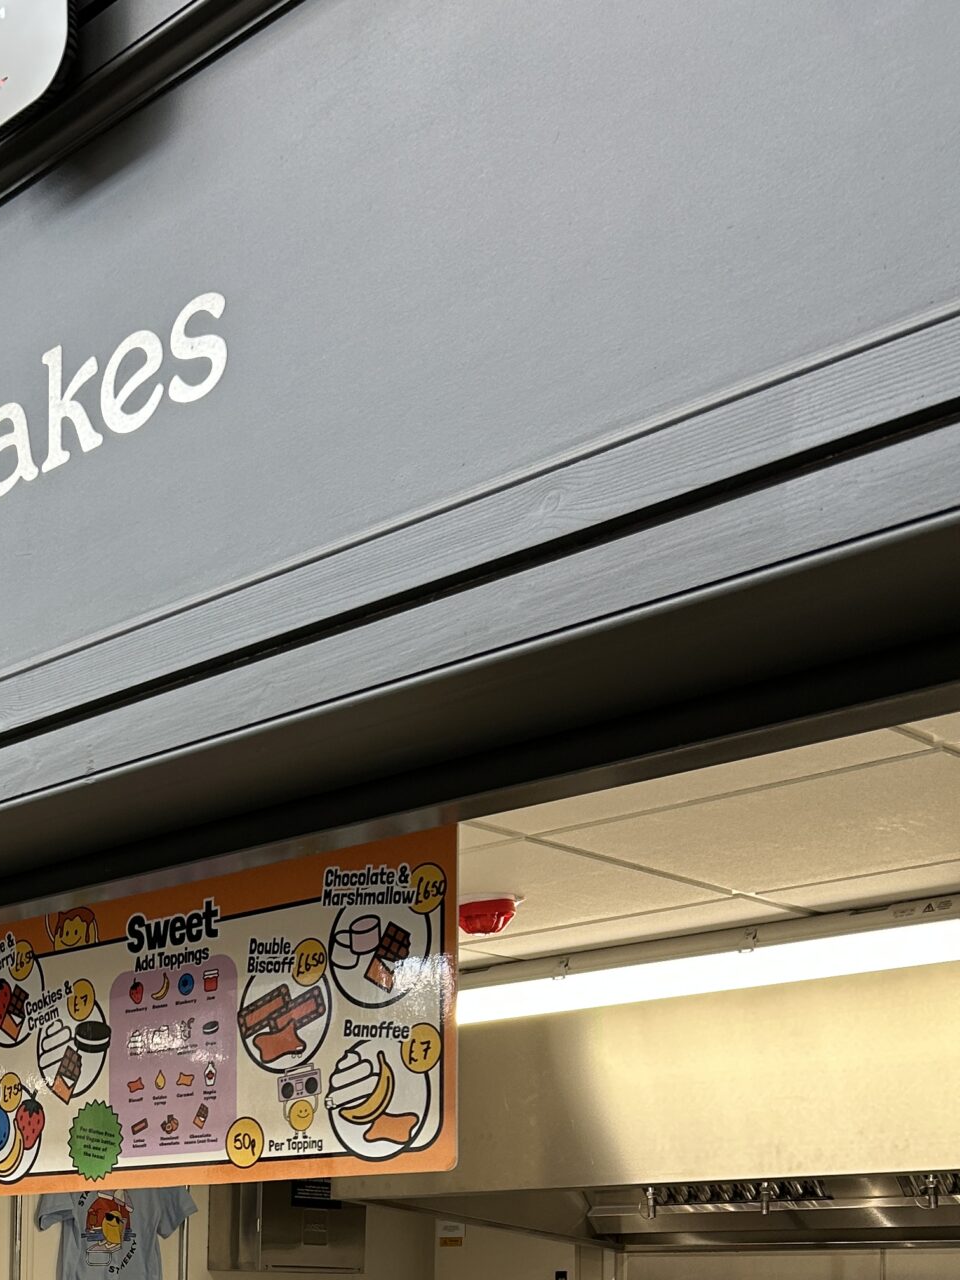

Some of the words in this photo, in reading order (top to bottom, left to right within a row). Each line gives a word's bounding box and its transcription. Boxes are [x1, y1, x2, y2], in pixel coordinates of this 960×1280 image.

[325, 866, 395, 887] Chocolate
[398, 866, 409, 883] &
[323, 887, 416, 906] Marshmallow
[127, 900, 218, 953] Sweet
[7, 933, 15, 948] &
[249, 938, 290, 955] Double
[135, 953, 156, 972] Add
[158, 947, 209, 970] Toppings
[248, 956, 294, 973] Biscoff
[26, 989, 62, 1016] Cookies
[64, 980, 73, 995] &
[74, 994, 88, 1014] £7
[28, 1007, 59, 1031] Cream
[344, 1019, 410, 1039] Banoffee
[409, 1039, 432, 1065] £7
[233, 1133, 257, 1157] 50p
[268, 1140, 285, 1152] Per
[287, 1136, 323, 1153] Topping
